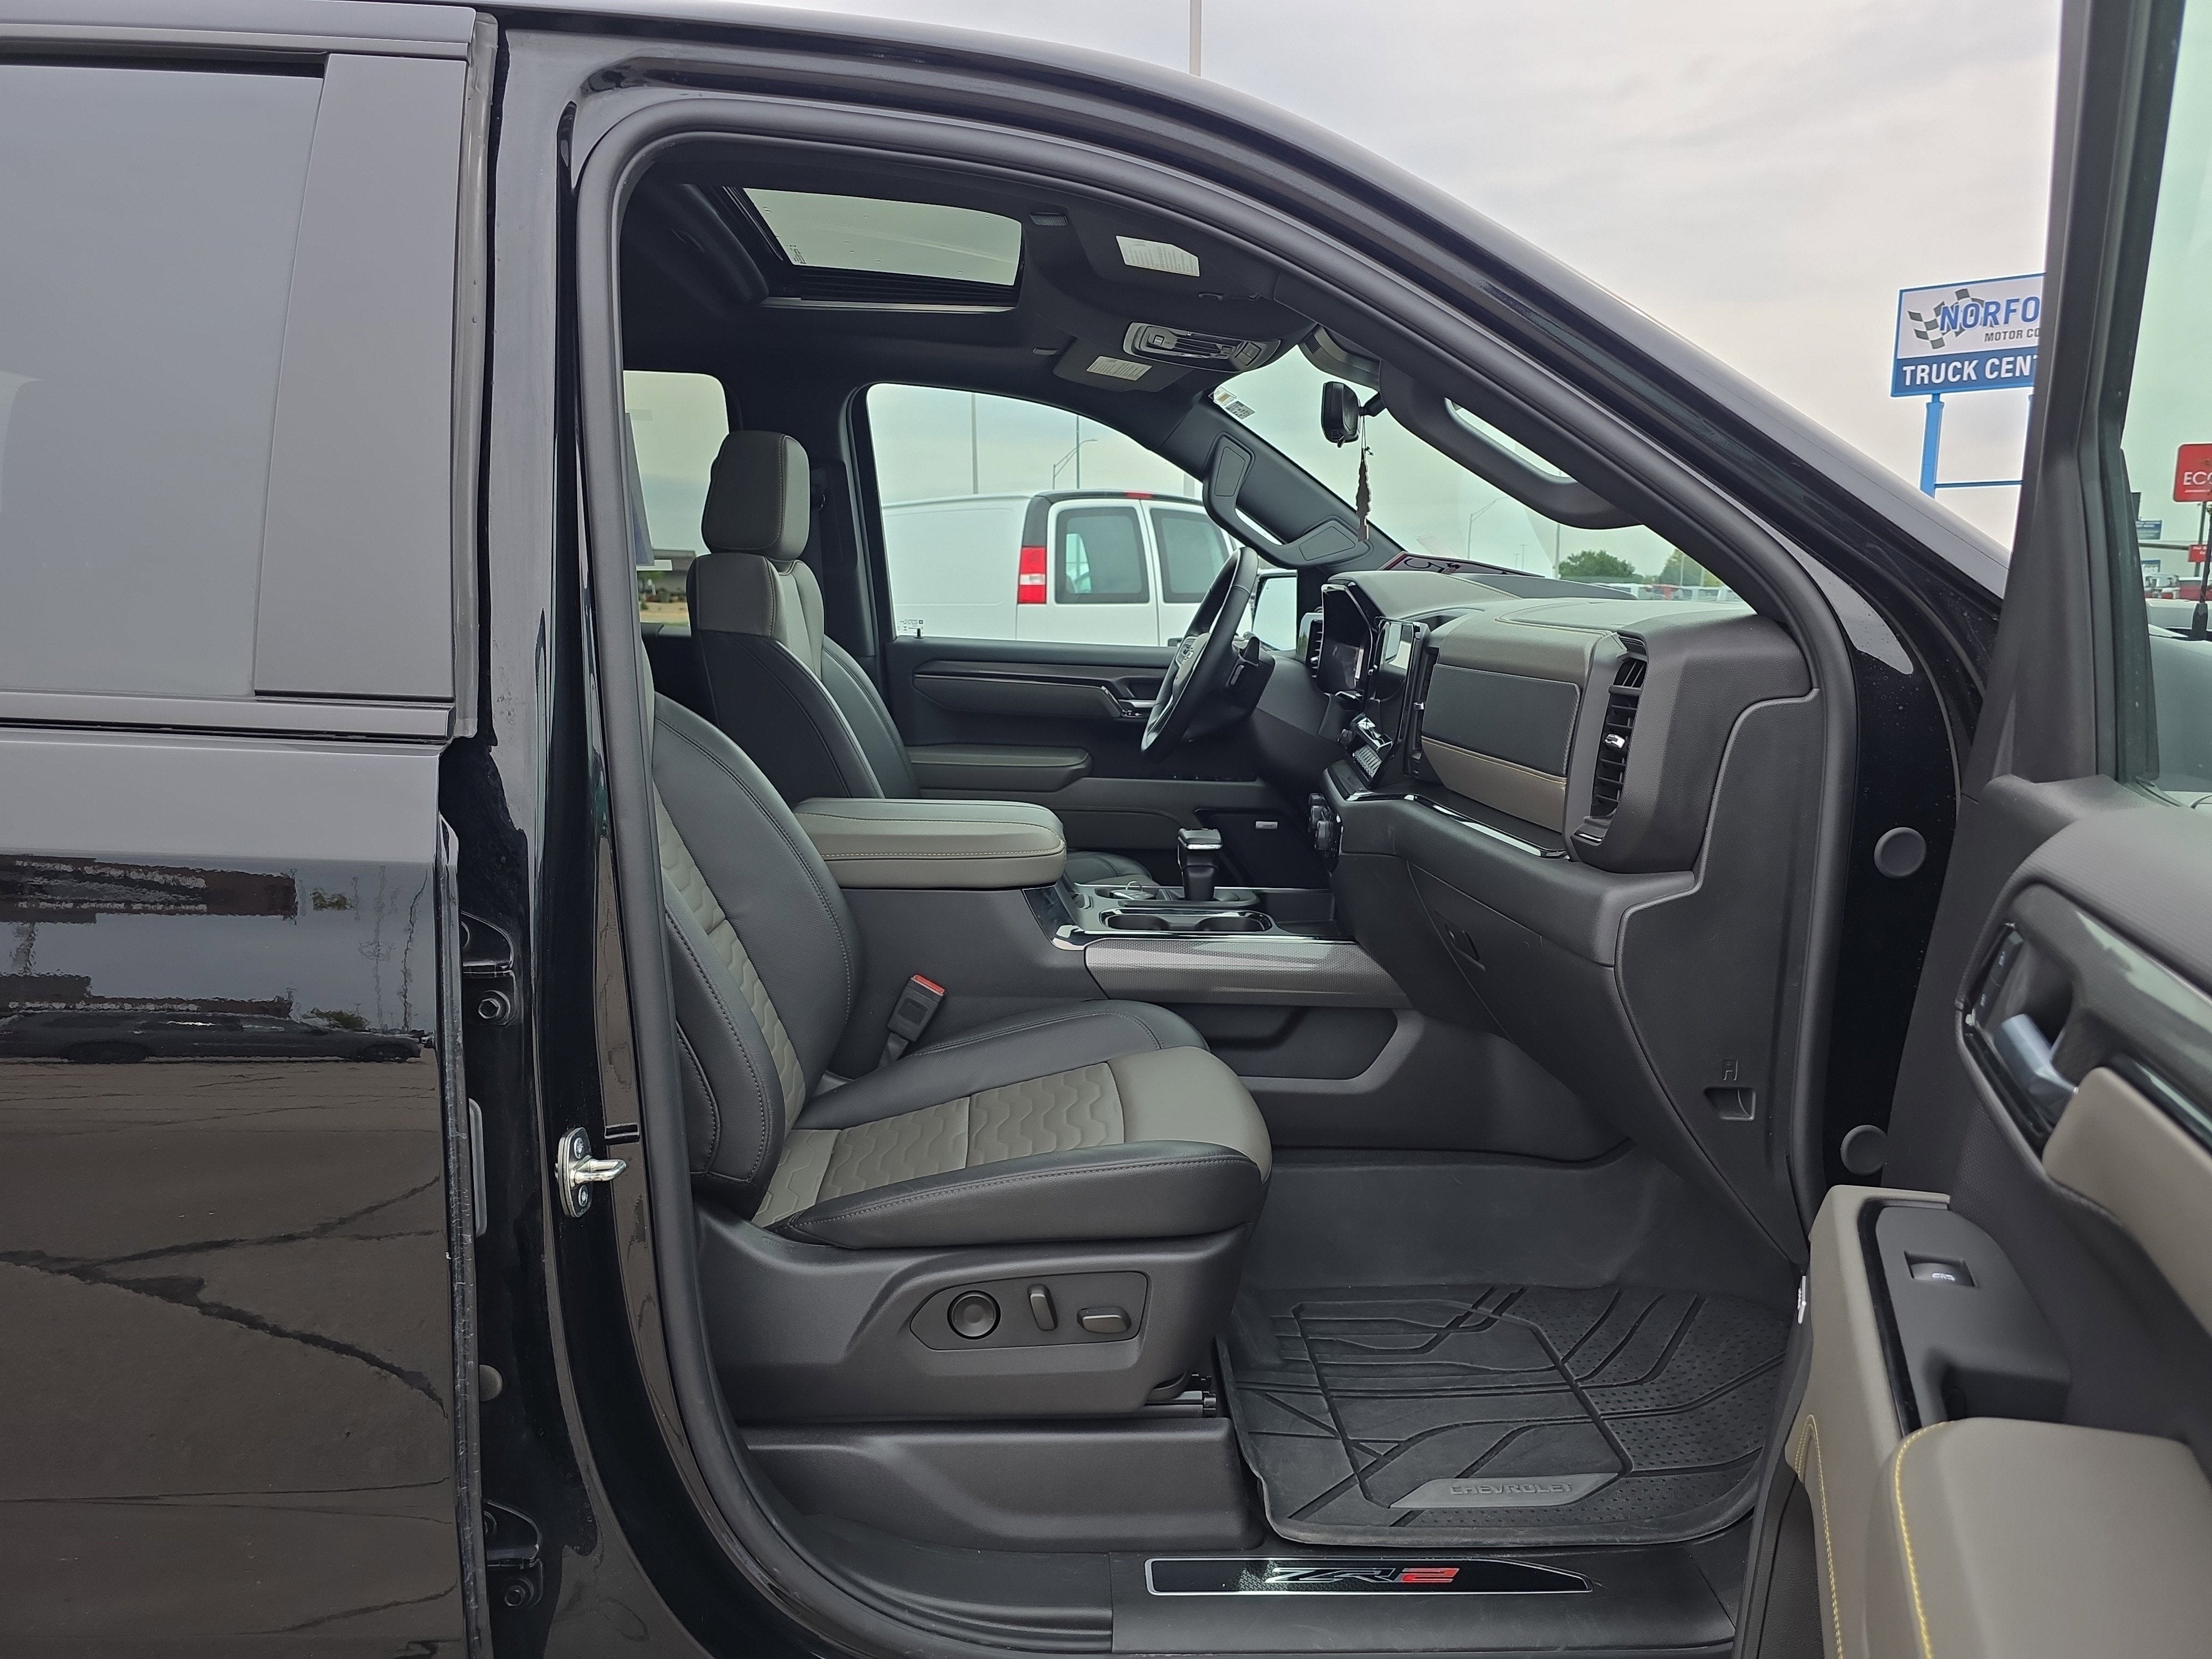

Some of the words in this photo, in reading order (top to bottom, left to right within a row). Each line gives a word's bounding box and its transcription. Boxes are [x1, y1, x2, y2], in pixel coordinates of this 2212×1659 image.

[1984, 329, 2023, 342] MOTOR
[1902, 359, 1978, 386] TRUCK
[1450, 1483, 1572, 1495] CHEVROLET
[1264, 1567, 1460, 1583] ZR2
